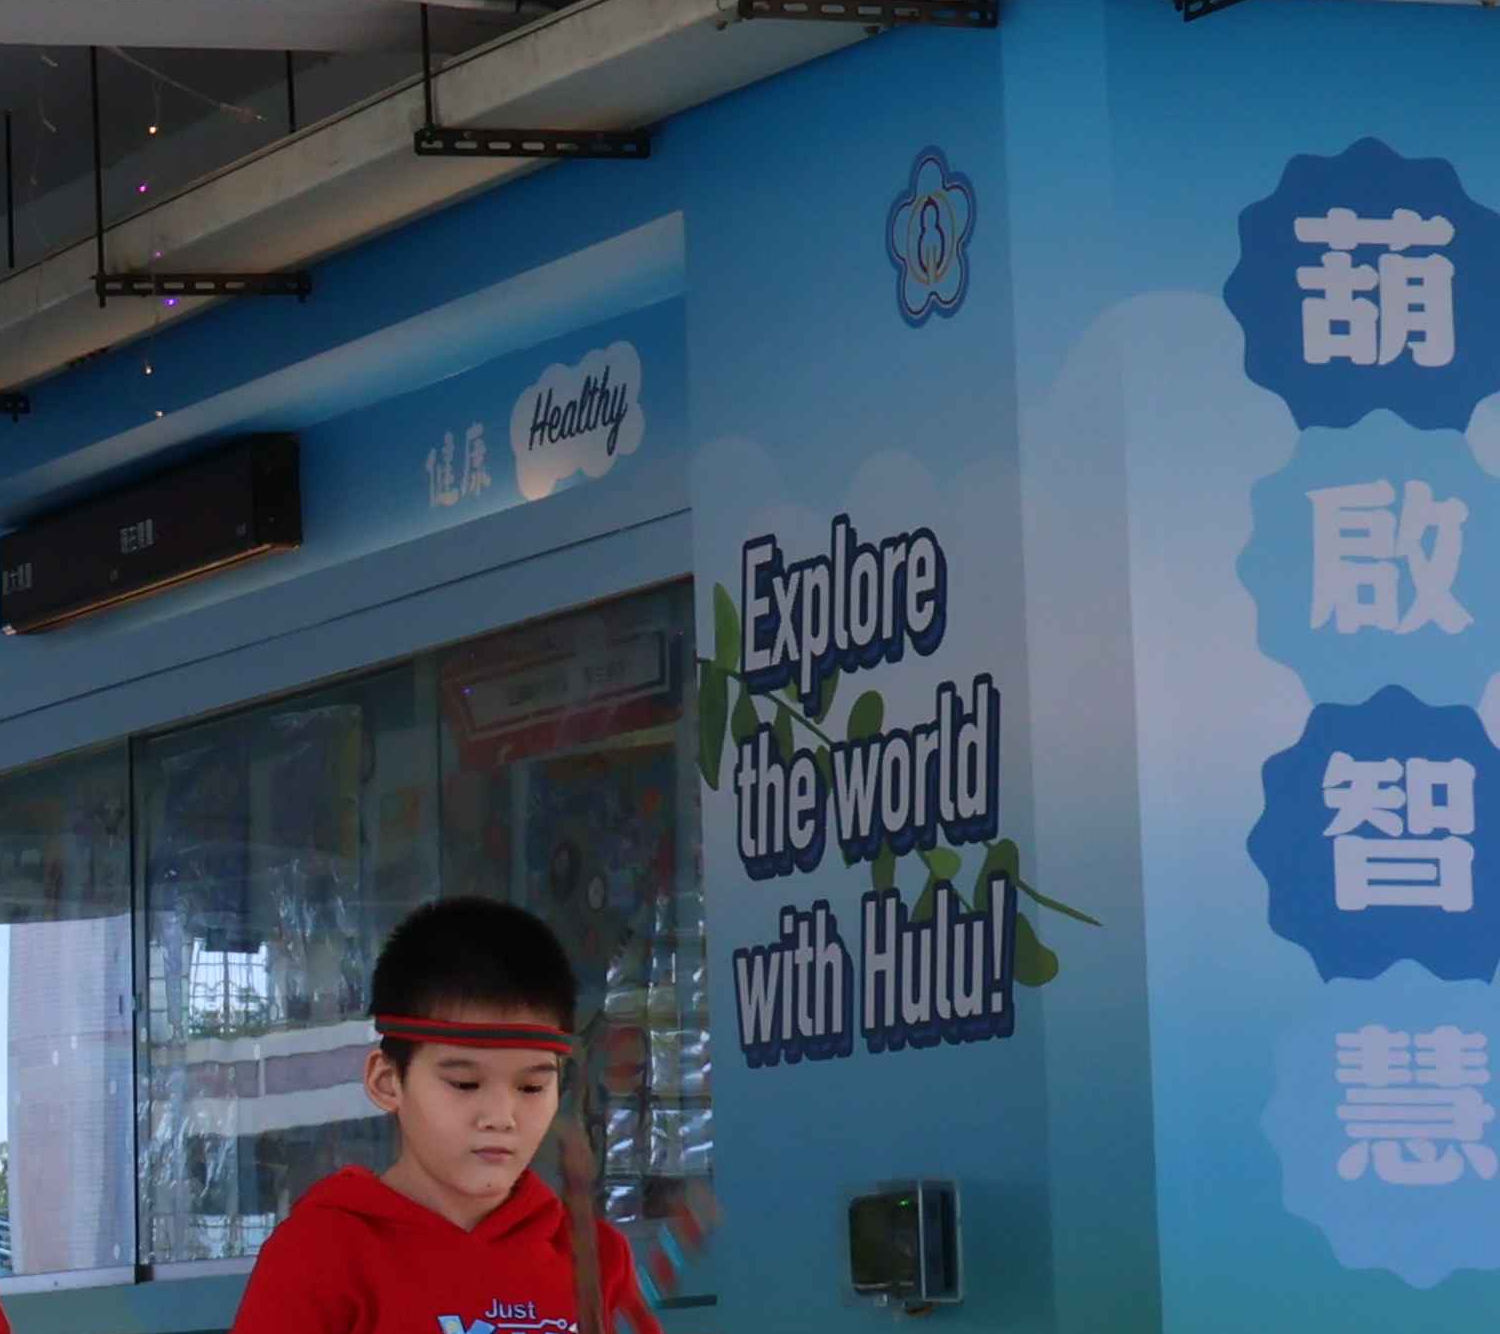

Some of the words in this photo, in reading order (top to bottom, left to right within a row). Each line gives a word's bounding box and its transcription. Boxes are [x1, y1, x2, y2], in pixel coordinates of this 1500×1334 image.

[426, 421, 492, 507] 健康
[528, 365, 628, 456] Healthy
[743, 519, 943, 689] Explore
[736, 725, 825, 873] the
[831, 679, 997, 851] world
[736, 915, 850, 1060] with
[861, 883, 1014, 1050] Hulu!
[485, 1299, 538, 1320] Just
